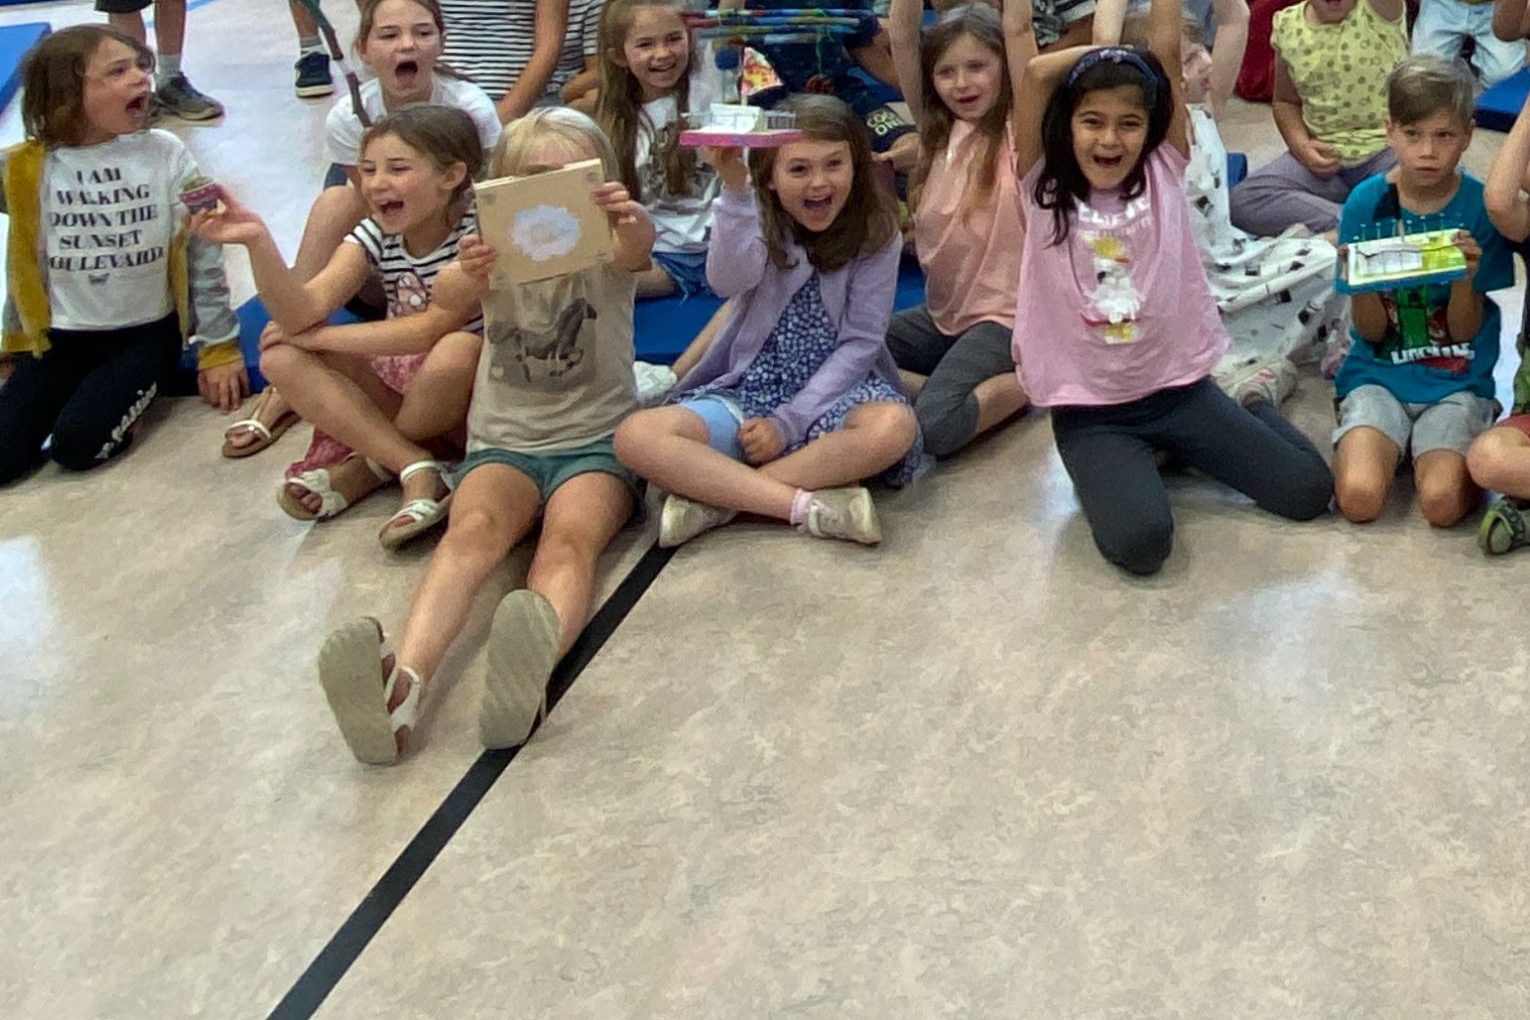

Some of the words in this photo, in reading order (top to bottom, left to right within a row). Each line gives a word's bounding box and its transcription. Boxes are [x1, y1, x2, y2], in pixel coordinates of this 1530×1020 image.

[89, 167, 122, 184] AM
[56, 183, 150, 205] WALKING
[116, 204, 159, 226] THE
[59, 229, 142, 250] SUNSET
[50, 246, 164, 272] OULEVARD
